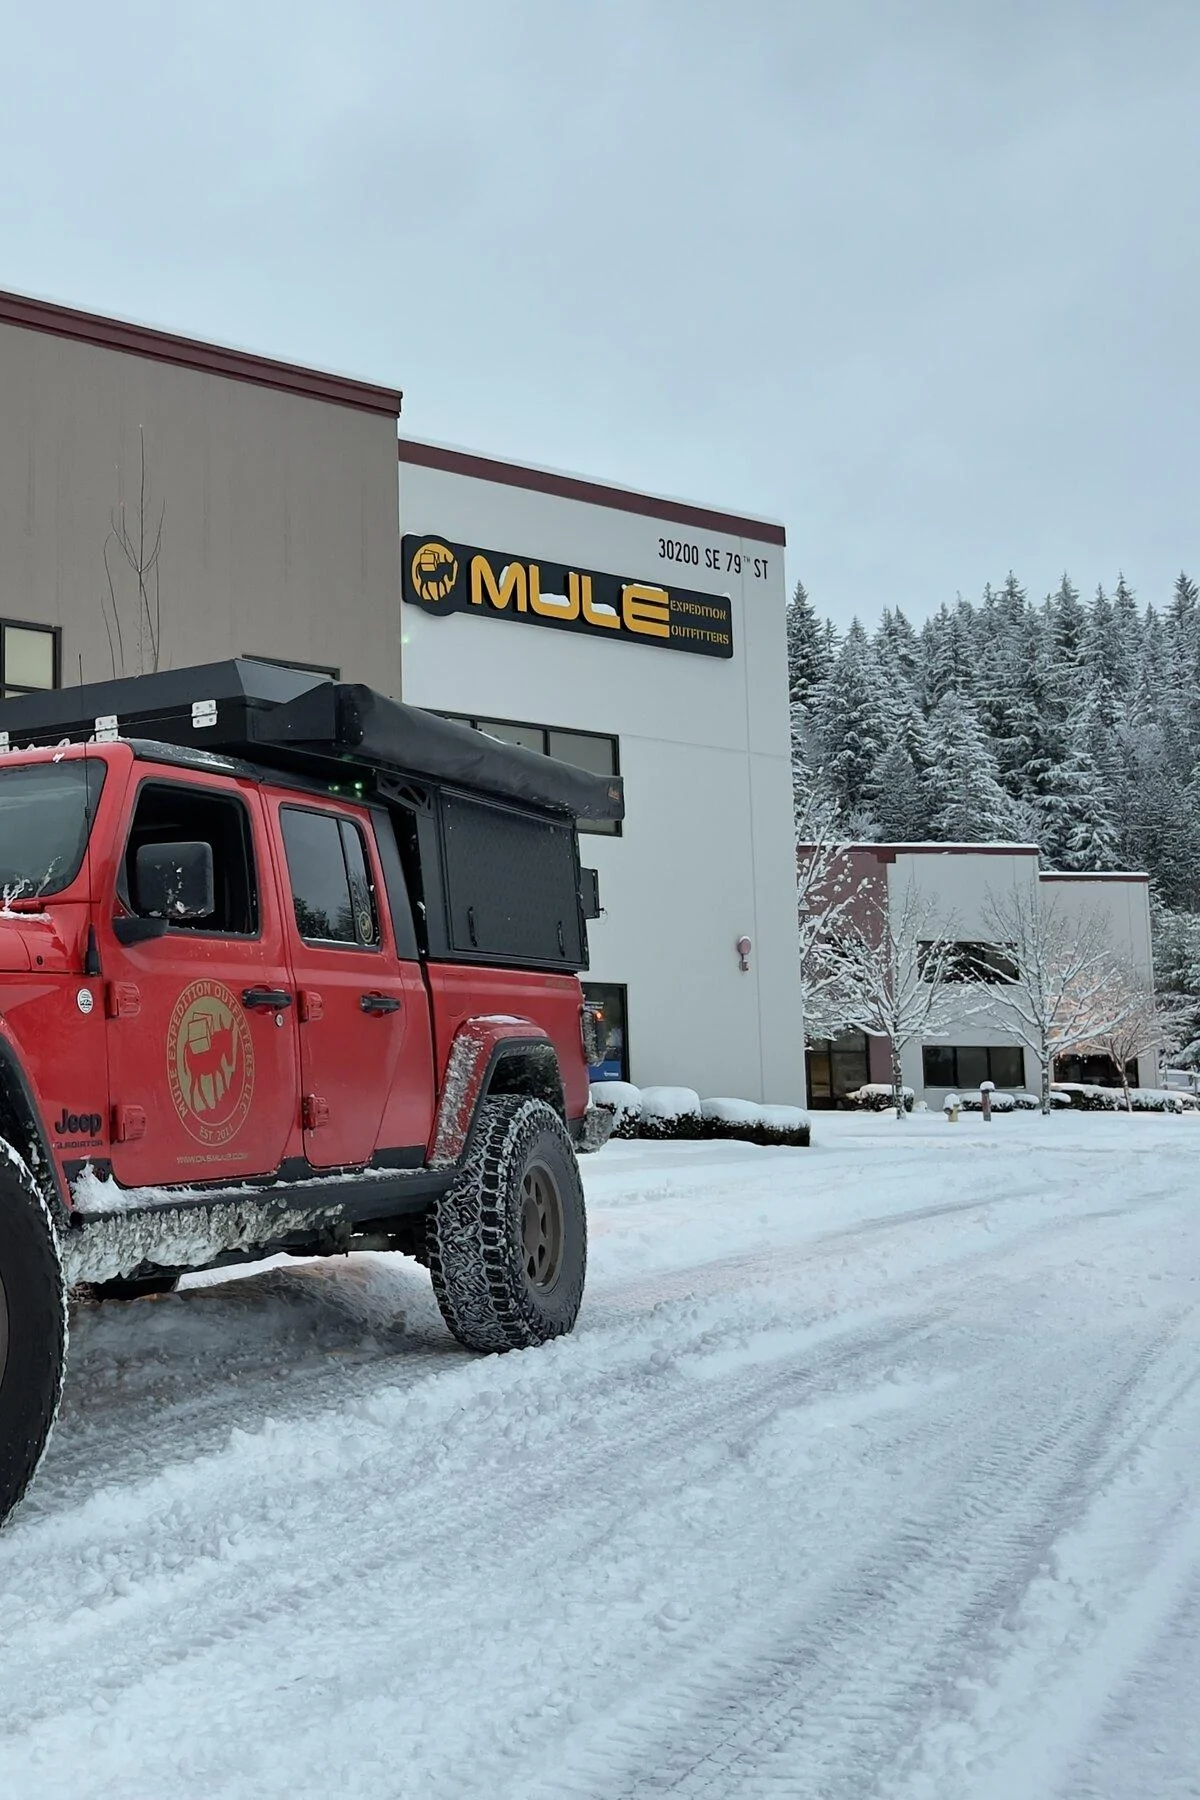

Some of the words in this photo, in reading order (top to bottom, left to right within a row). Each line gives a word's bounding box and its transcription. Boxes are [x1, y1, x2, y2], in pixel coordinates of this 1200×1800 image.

[658, 538, 699, 566] 30200
[705, 548, 721, 570] SE
[754, 558, 769, 580] ST
[471, 554, 670, 638] MULE
[670, 600, 727, 620] EXPEDITION
[671, 624, 730, 645] OUTFITTERS
[168, 981, 211, 1061] EXPEDITION
[214, 985, 254, 1077] OUTFITTERS
[169, 1068, 189, 1119] MULE
[240, 1083, 252, 1115] LLC
[54, 1108, 102, 1138] Jeep
